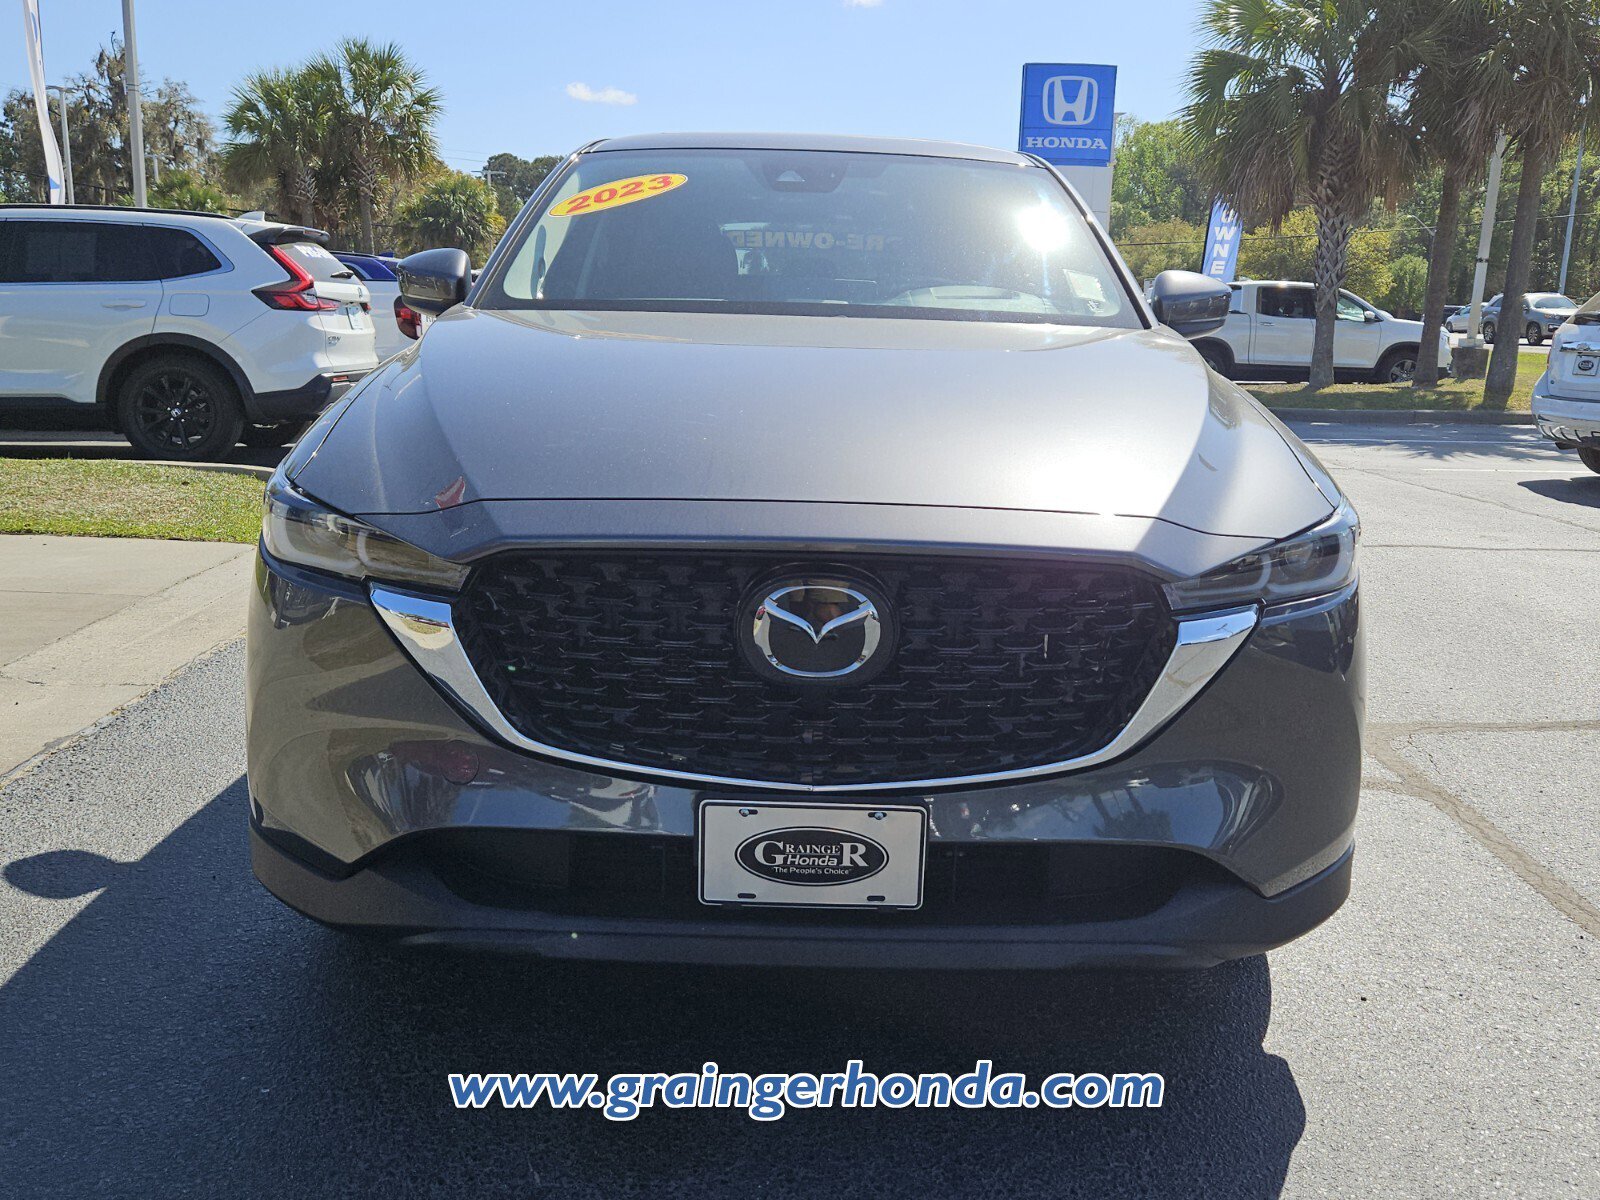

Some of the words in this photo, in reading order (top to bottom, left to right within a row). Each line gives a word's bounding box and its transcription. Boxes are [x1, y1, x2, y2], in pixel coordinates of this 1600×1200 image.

[1025, 136, 1108, 150] HONDA
[566, 175, 673, 214] 2023
[786, 854, 838, 866] Honda
